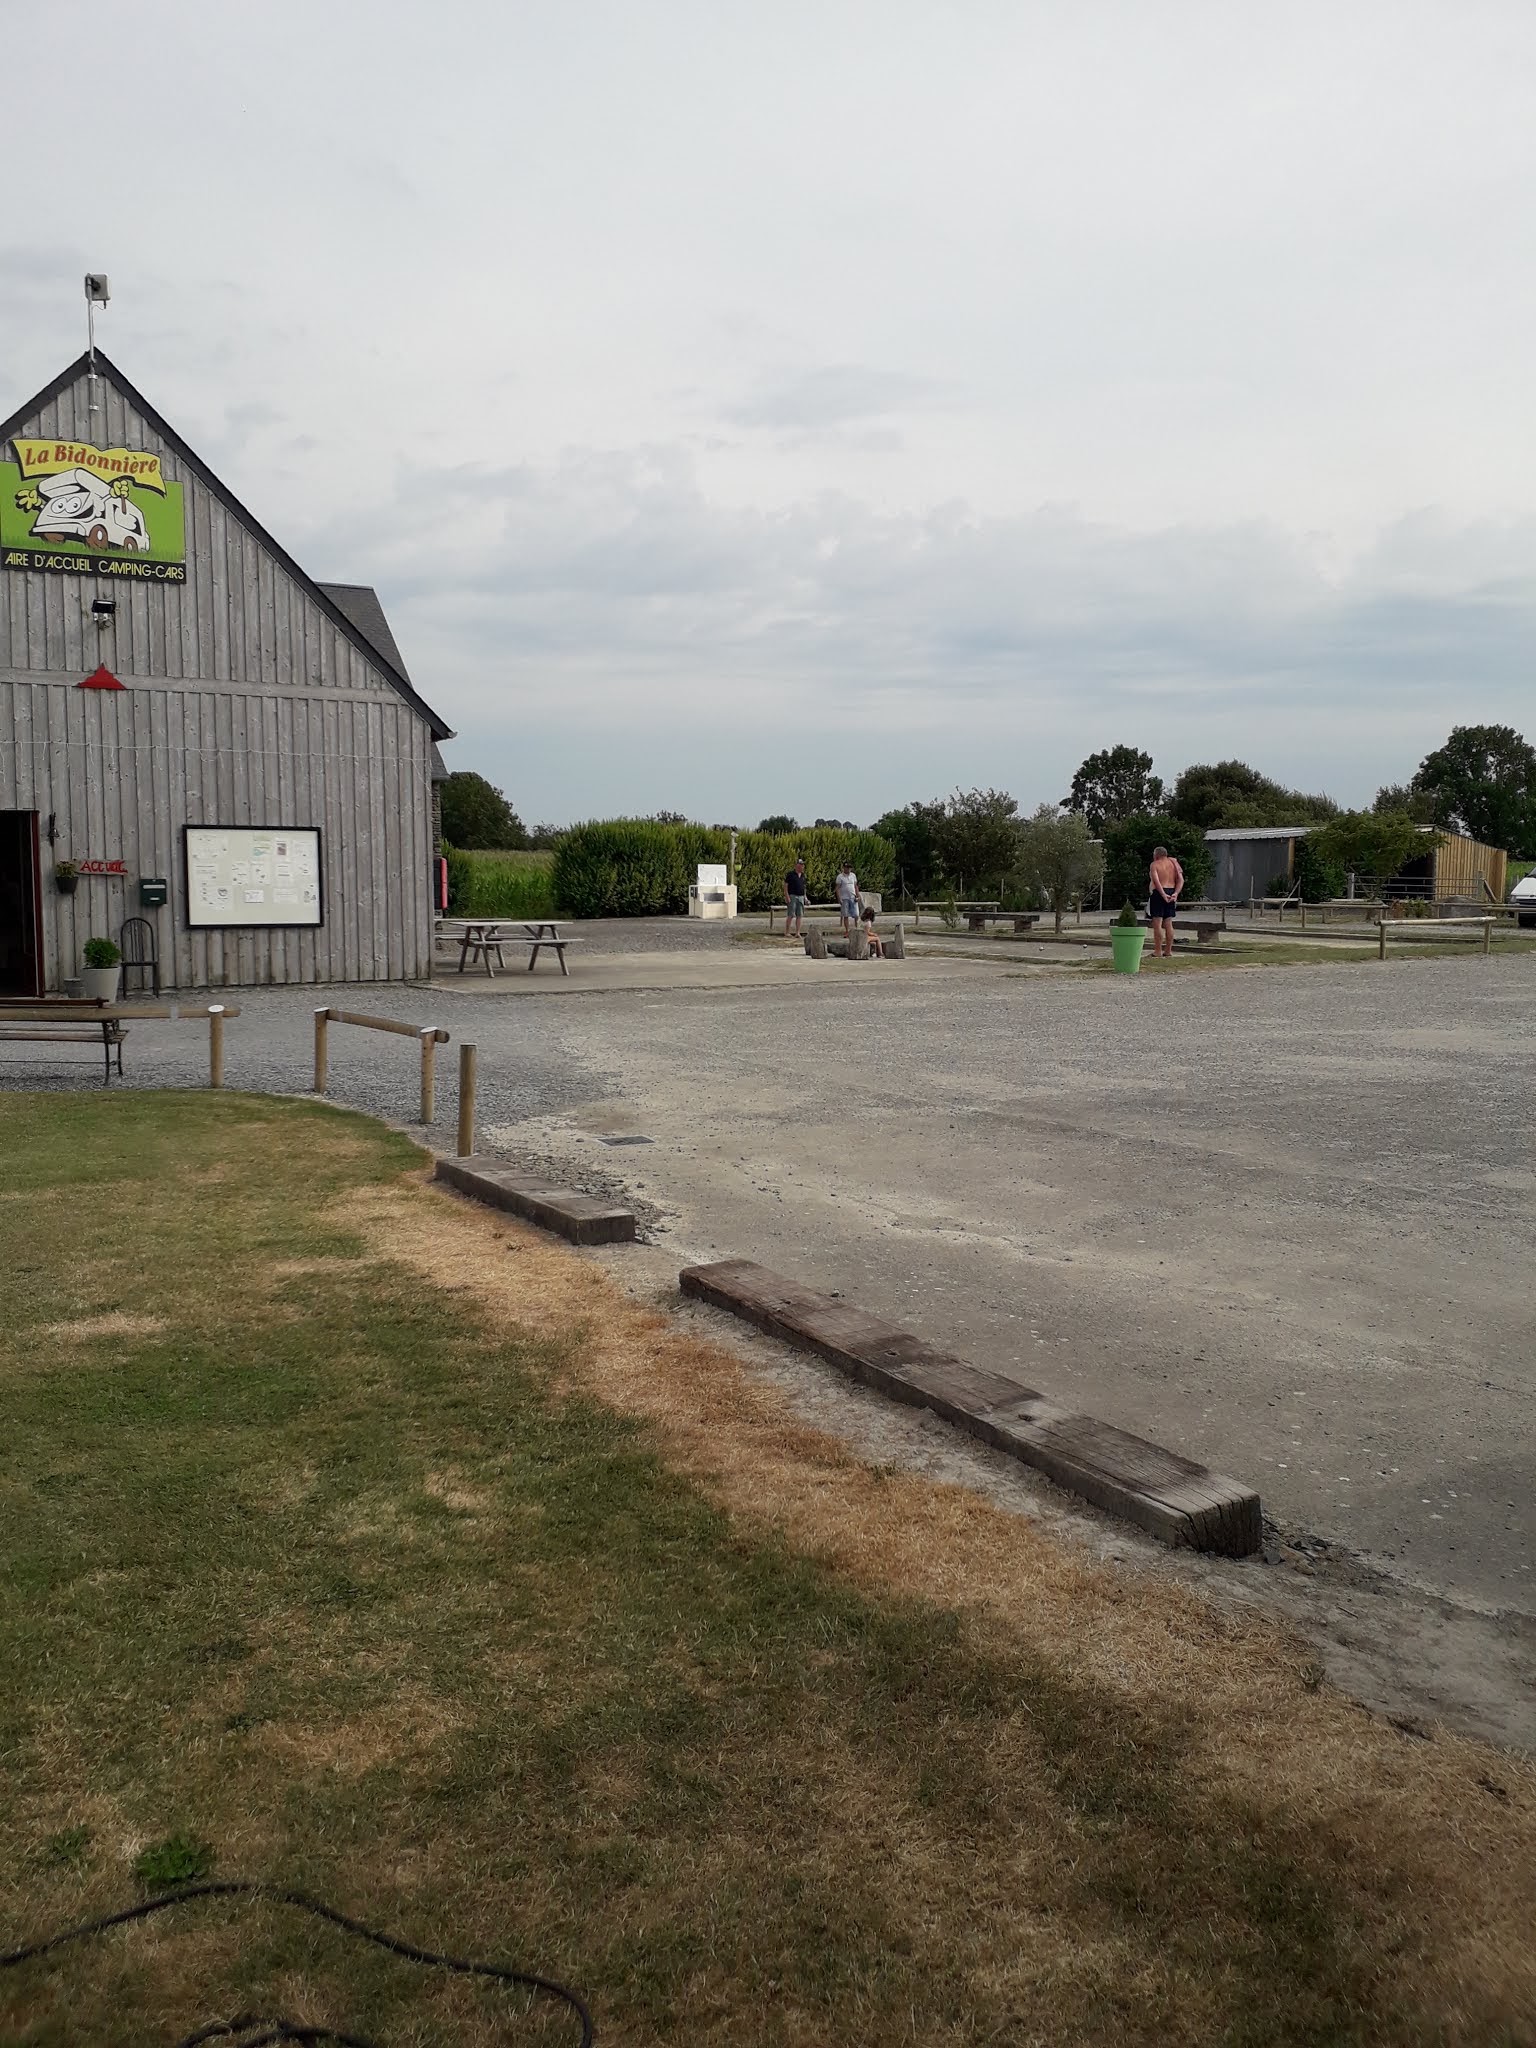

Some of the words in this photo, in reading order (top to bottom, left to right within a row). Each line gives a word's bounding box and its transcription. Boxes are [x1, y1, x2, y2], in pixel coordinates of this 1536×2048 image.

[25, 447, 49, 466] La
[54, 444, 158, 474] Bidonnière
[5, 552, 29, 566] AIRE
[34, 554, 93, 572] D'ACCUEIL
[98, 560, 185, 580] CAMPING-CARS
